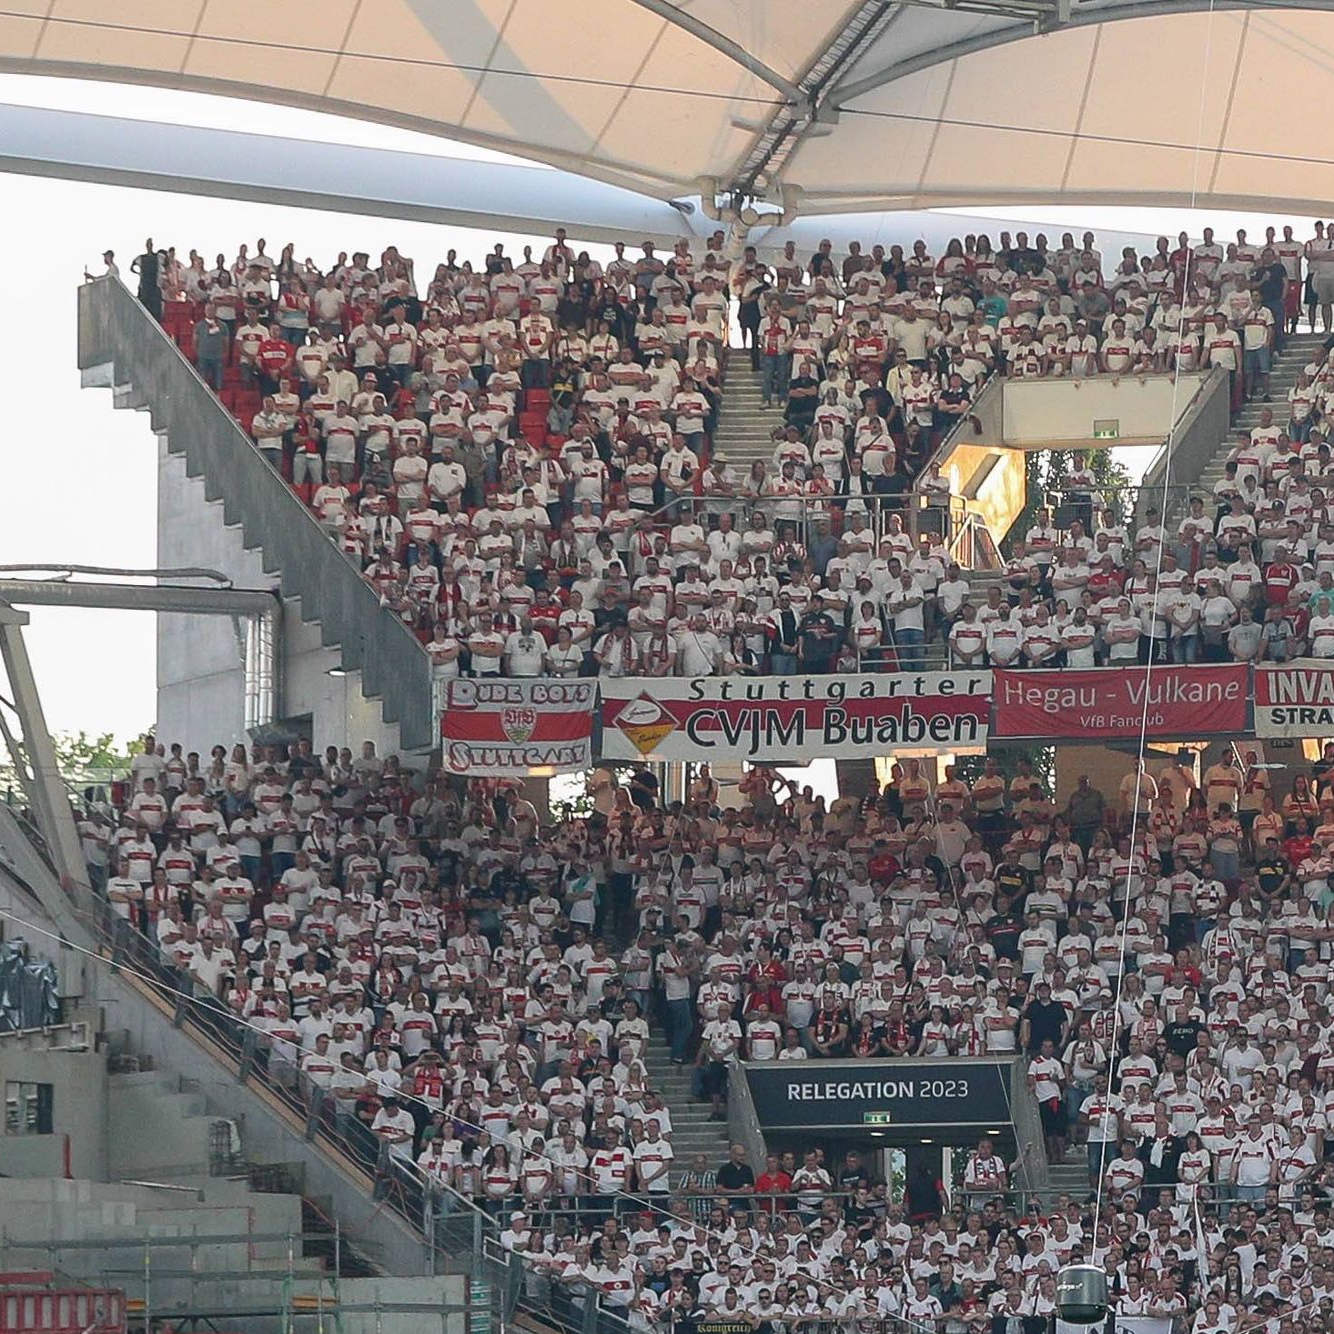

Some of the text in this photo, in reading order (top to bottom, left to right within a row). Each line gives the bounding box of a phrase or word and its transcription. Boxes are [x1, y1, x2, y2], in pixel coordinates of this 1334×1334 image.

[688, 677, 981, 704] Stuttgarter
[1004, 680, 1096, 713] Hegau
[1125, 677, 1240, 705] Vulkane
[687, 704, 978, 755] CVJM Buaben
[1080, 715, 1106, 728] VfB
[788, 1081, 968, 1100] RELEGATION 2023
